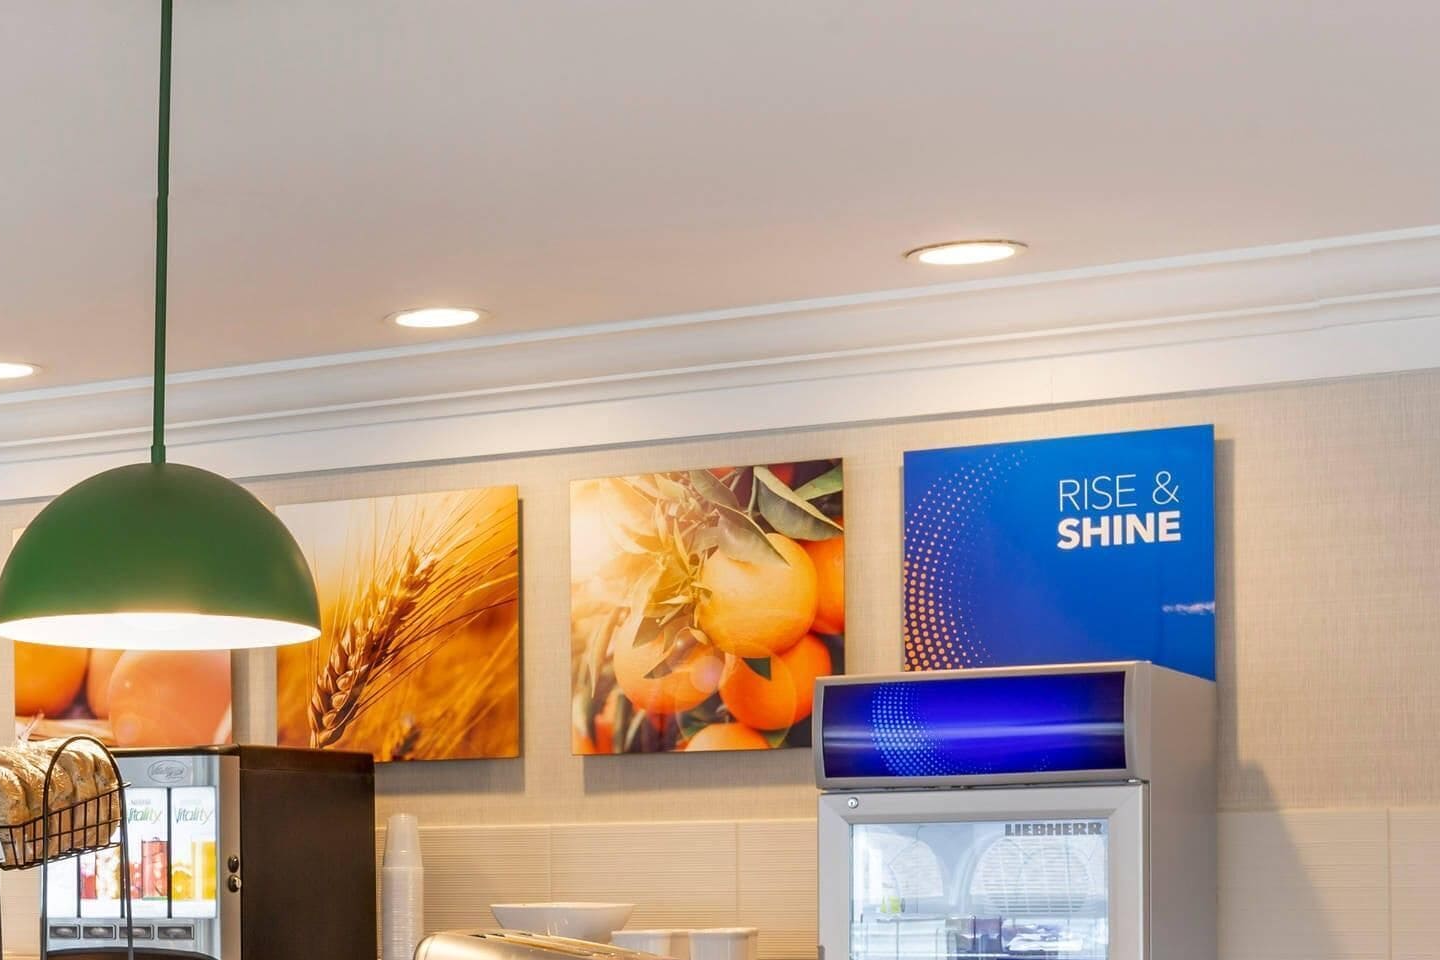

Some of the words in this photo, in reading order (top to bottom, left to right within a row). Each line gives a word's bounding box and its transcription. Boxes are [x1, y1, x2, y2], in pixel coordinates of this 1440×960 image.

[1059, 474, 1137, 512] RISE
[1152, 471, 1180, 506] &
[1057, 511, 1181, 550] SHINE
[1004, 822, 1103, 837] LIEBHERR
